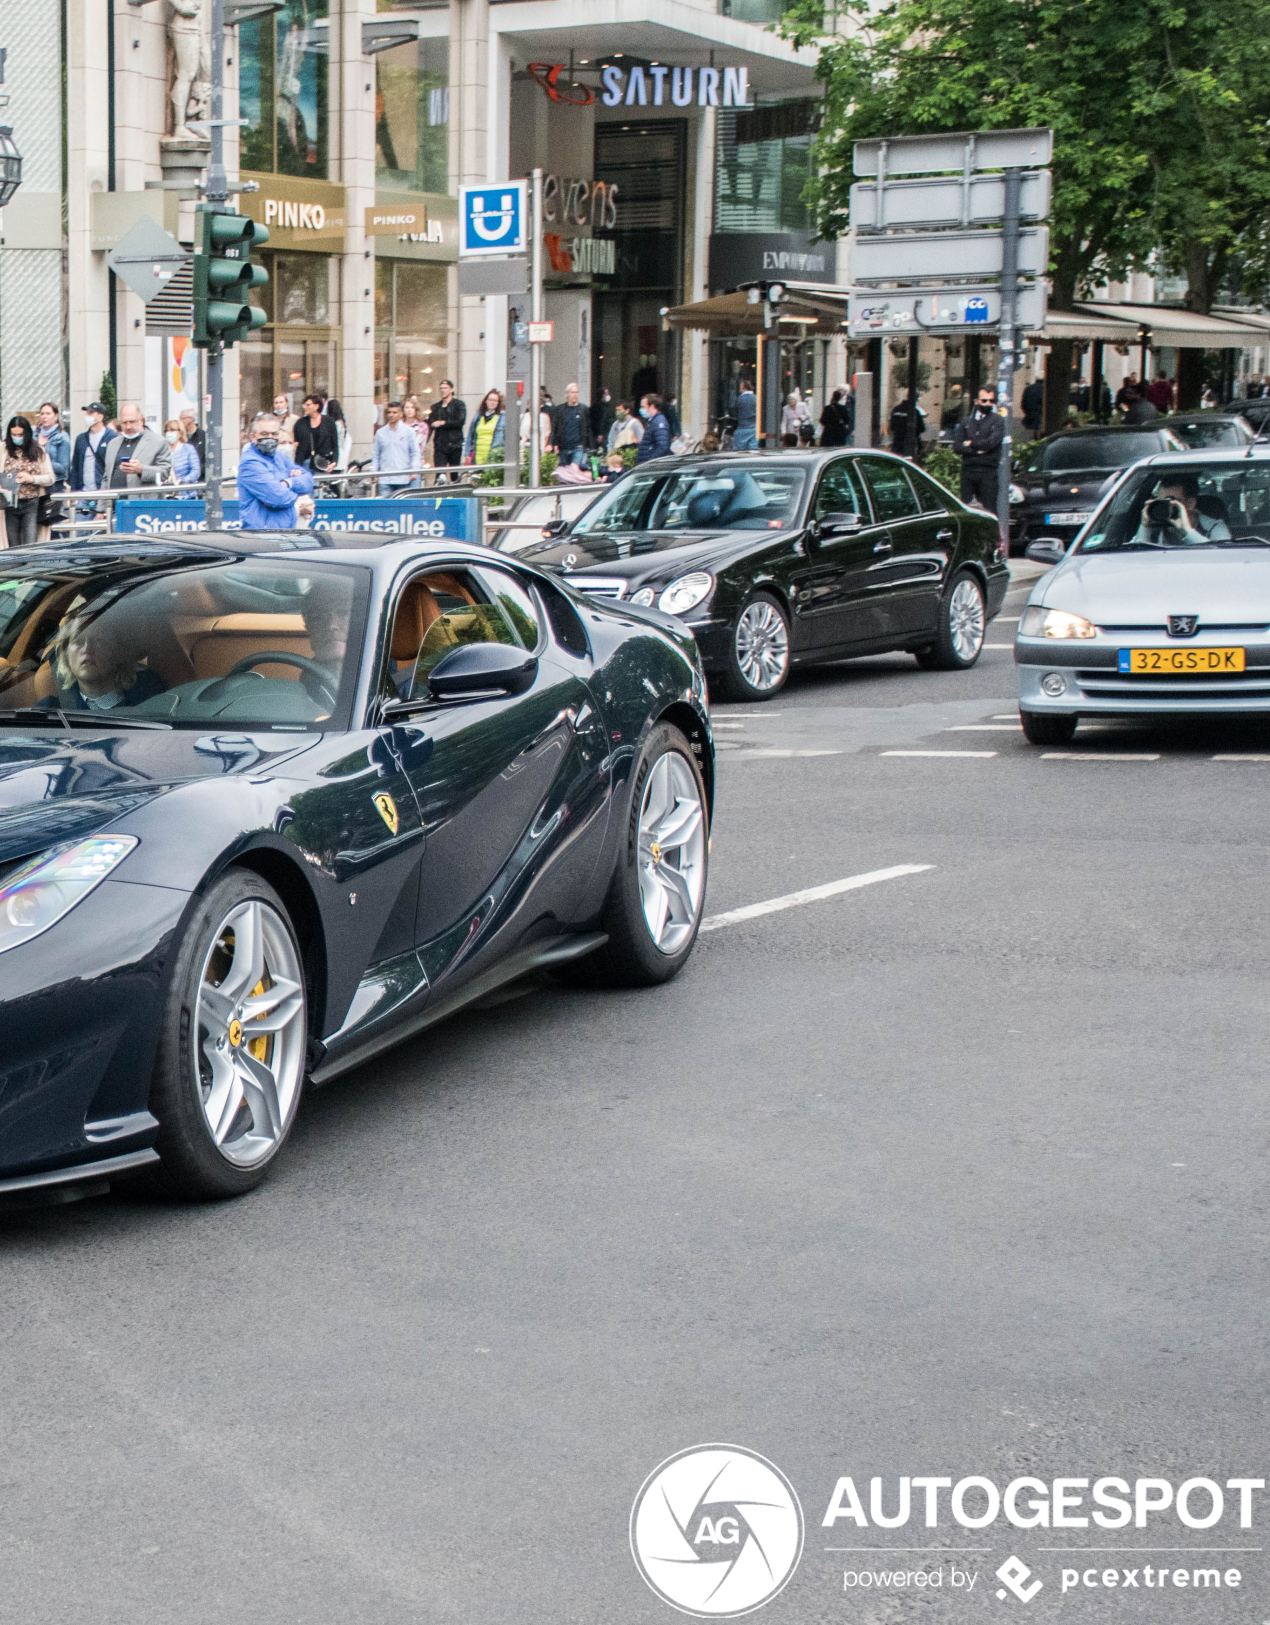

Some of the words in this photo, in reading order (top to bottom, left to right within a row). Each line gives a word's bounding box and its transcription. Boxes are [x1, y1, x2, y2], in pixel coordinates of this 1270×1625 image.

[602, 66, 748, 106] SATURN
[264, 199, 326, 230] PINKO
[373, 214, 416, 226] PINKO
[571, 237, 616, 275] SATURN
[313, 514, 446, 537] önigsallee
[1136, 651, 1237, 669] 32-GS-DK
